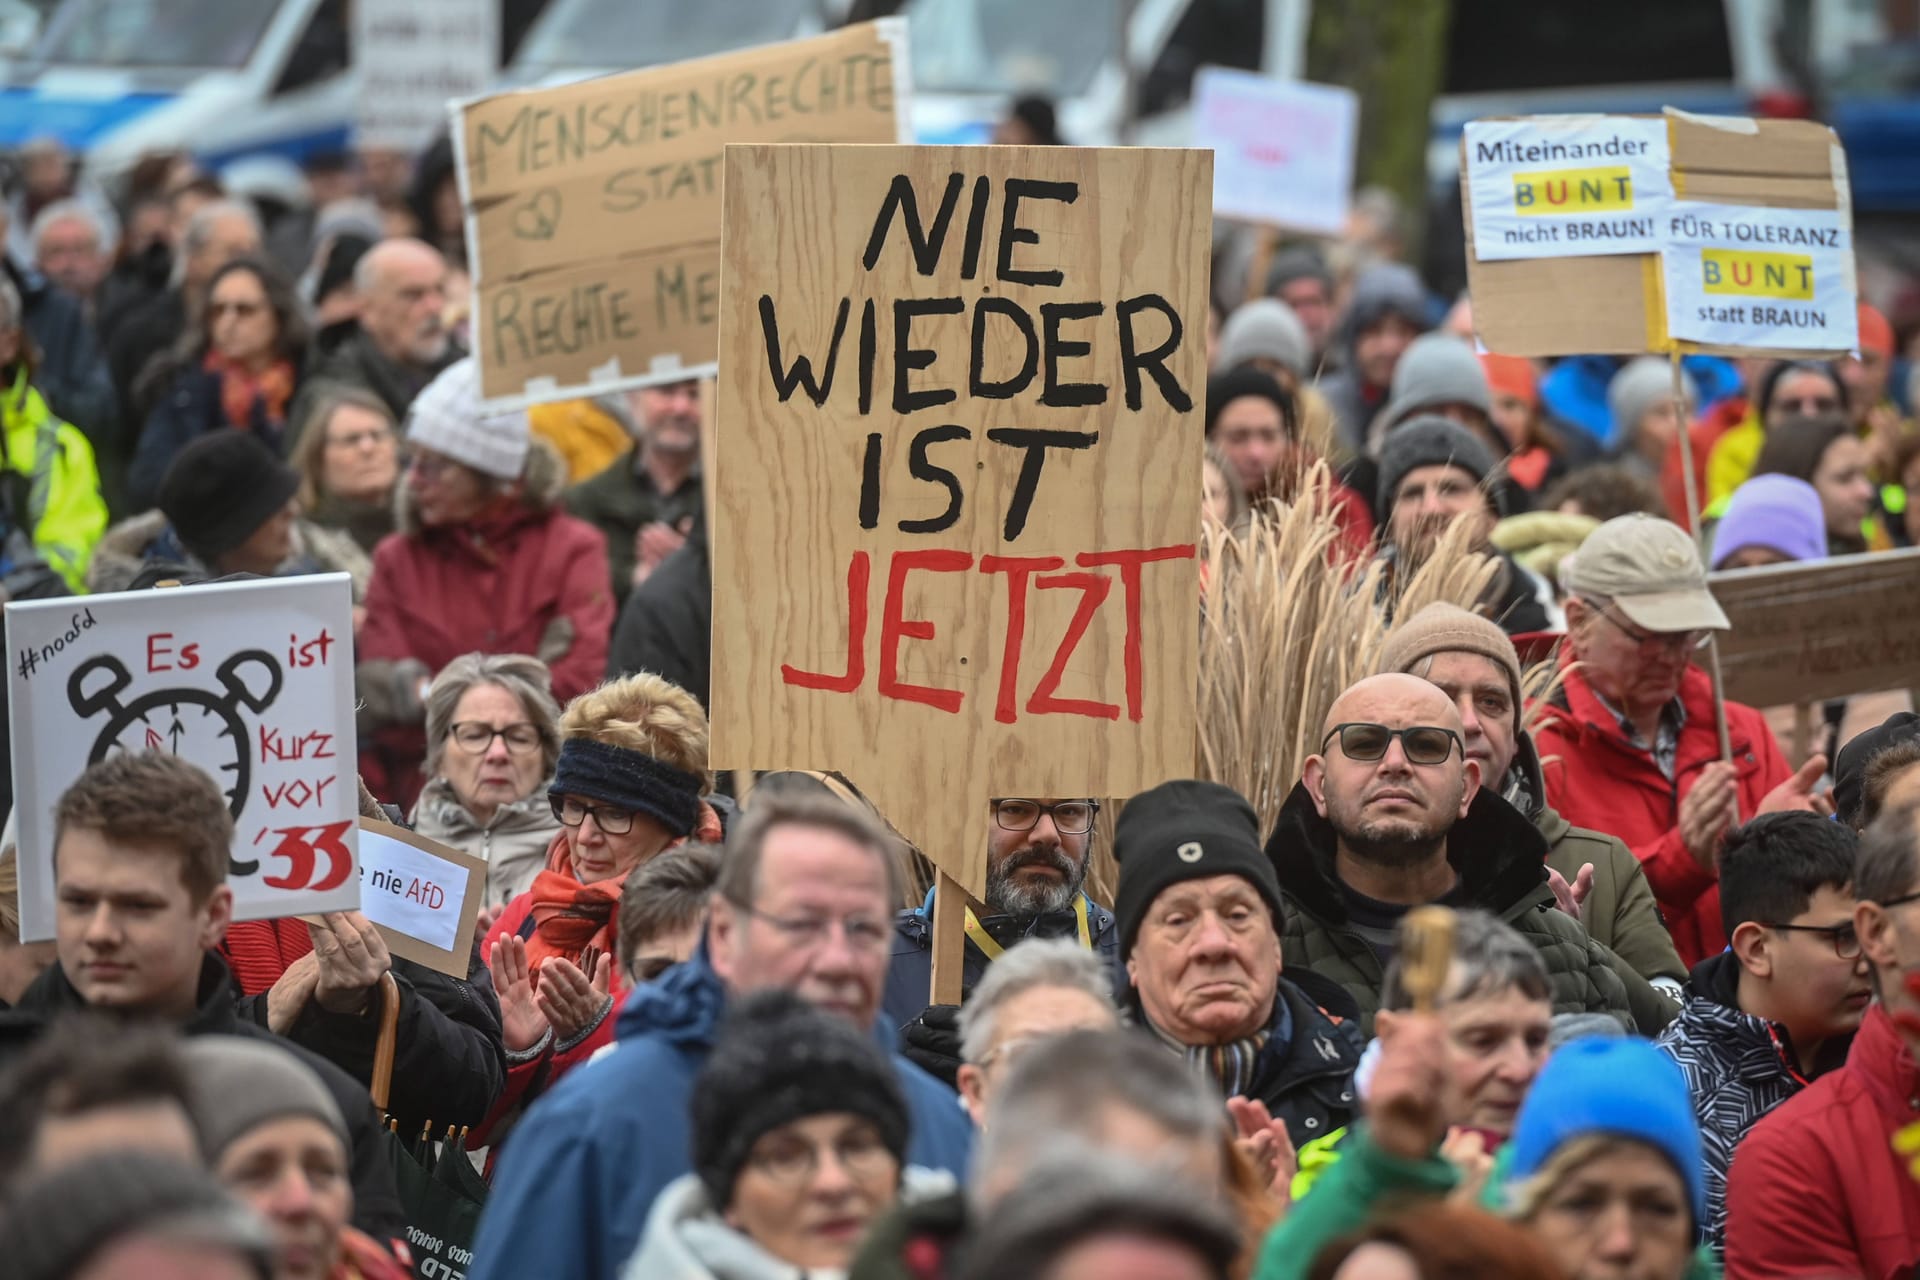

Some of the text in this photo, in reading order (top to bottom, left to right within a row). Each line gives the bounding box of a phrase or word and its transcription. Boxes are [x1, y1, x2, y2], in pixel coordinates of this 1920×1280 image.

[476, 53, 893, 185] MENSCHENRECHTE
[1477, 138, 1648, 162] Miteinander
[1514, 176, 1631, 207] BUNT
[862, 172, 1079, 287] NIE
[1504, 218, 1653, 243] nicht BRAUN!
[1670, 215, 1840, 248] FÜR TOLERANZ
[1704, 260, 1812, 290] BUNT
[493, 282, 638, 366] RECHTE
[1698, 304, 1826, 328] statt BRAUN
[758, 293, 1193, 415] WIEDER
[858, 424, 1099, 542] IST
[18, 607, 97, 680] #noafd
[147, 628, 335, 672] Es ist
[780, 543, 1196, 725] JETZT
[262, 775, 337, 809] vor
[371, 868, 402, 895] nie
[405, 878, 444, 910] AfD
